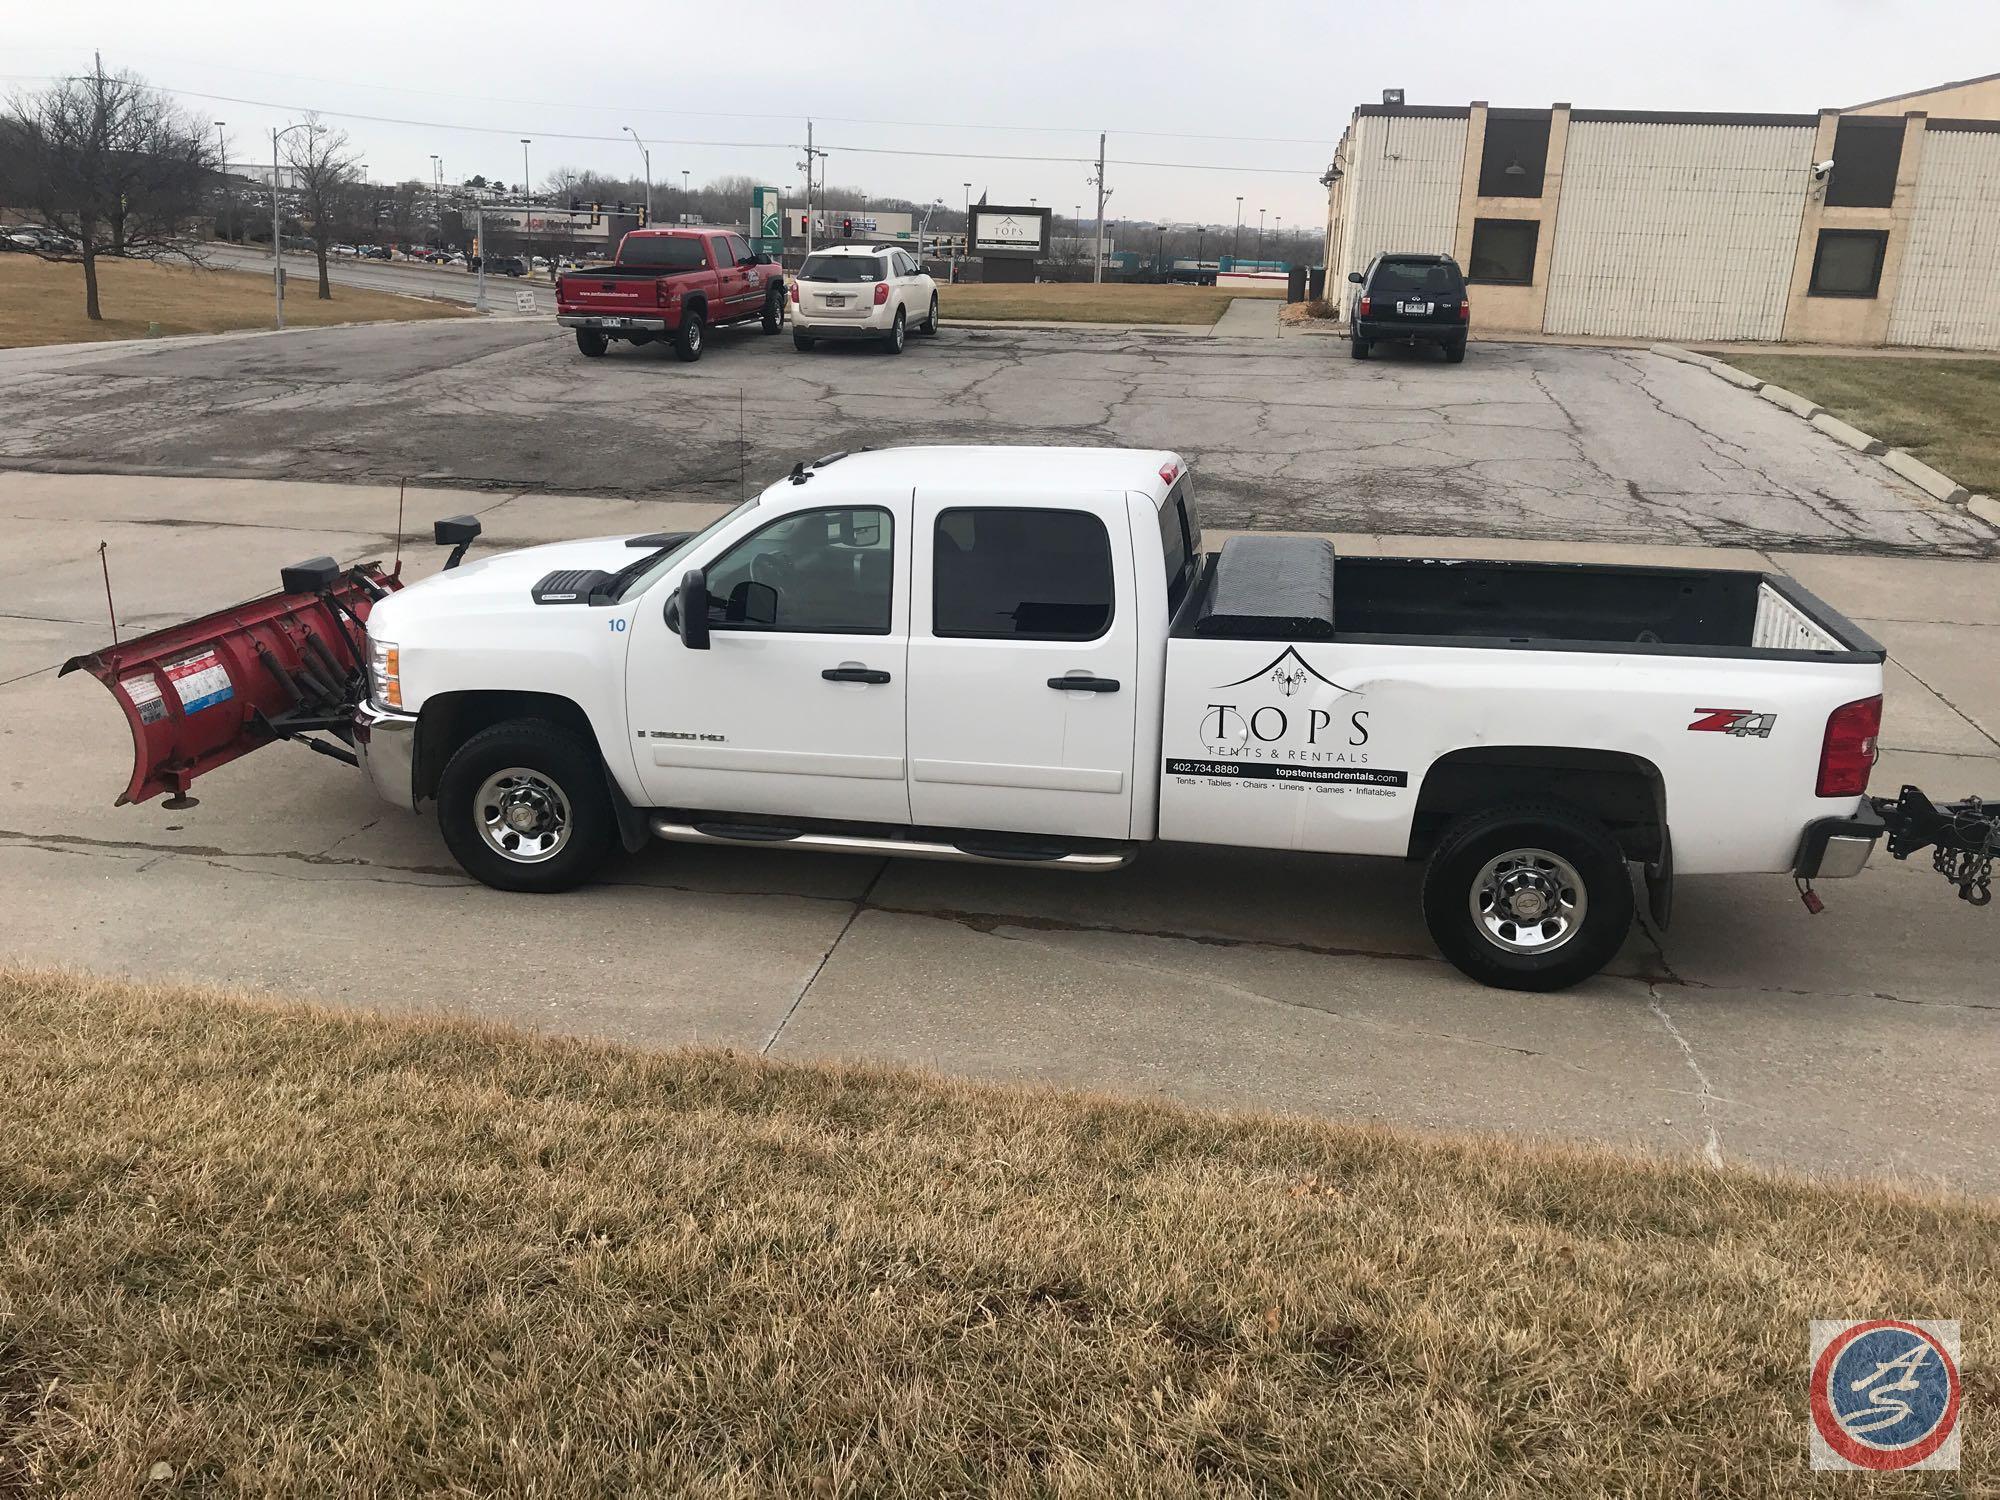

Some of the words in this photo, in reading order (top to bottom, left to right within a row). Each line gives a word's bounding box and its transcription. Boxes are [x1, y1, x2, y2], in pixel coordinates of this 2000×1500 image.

[994, 227, 1024, 236] TOPS
[608, 619, 626, 632] 10
[1206, 704, 1370, 747] TOPS
[700, 733, 725, 742] HD
[1207, 746, 1262, 758] TENTS
[1270, 749, 1279, 759] &
[1288, 751, 1369, 763] RENTALS
[1173, 763, 1240, 775] 402.734.8880
[1276, 768, 1398, 784] topstentsandrentals.com
[1176, 777, 1196, 785] Tents
[1207, 779, 1232, 788] Tables
[1242, 780, 1268, 789] Chairs
[1279, 782, 1305, 792] Linens
[1316, 785, 1345, 794] Games
[1356, 786, 1397, 798] Inflatables
